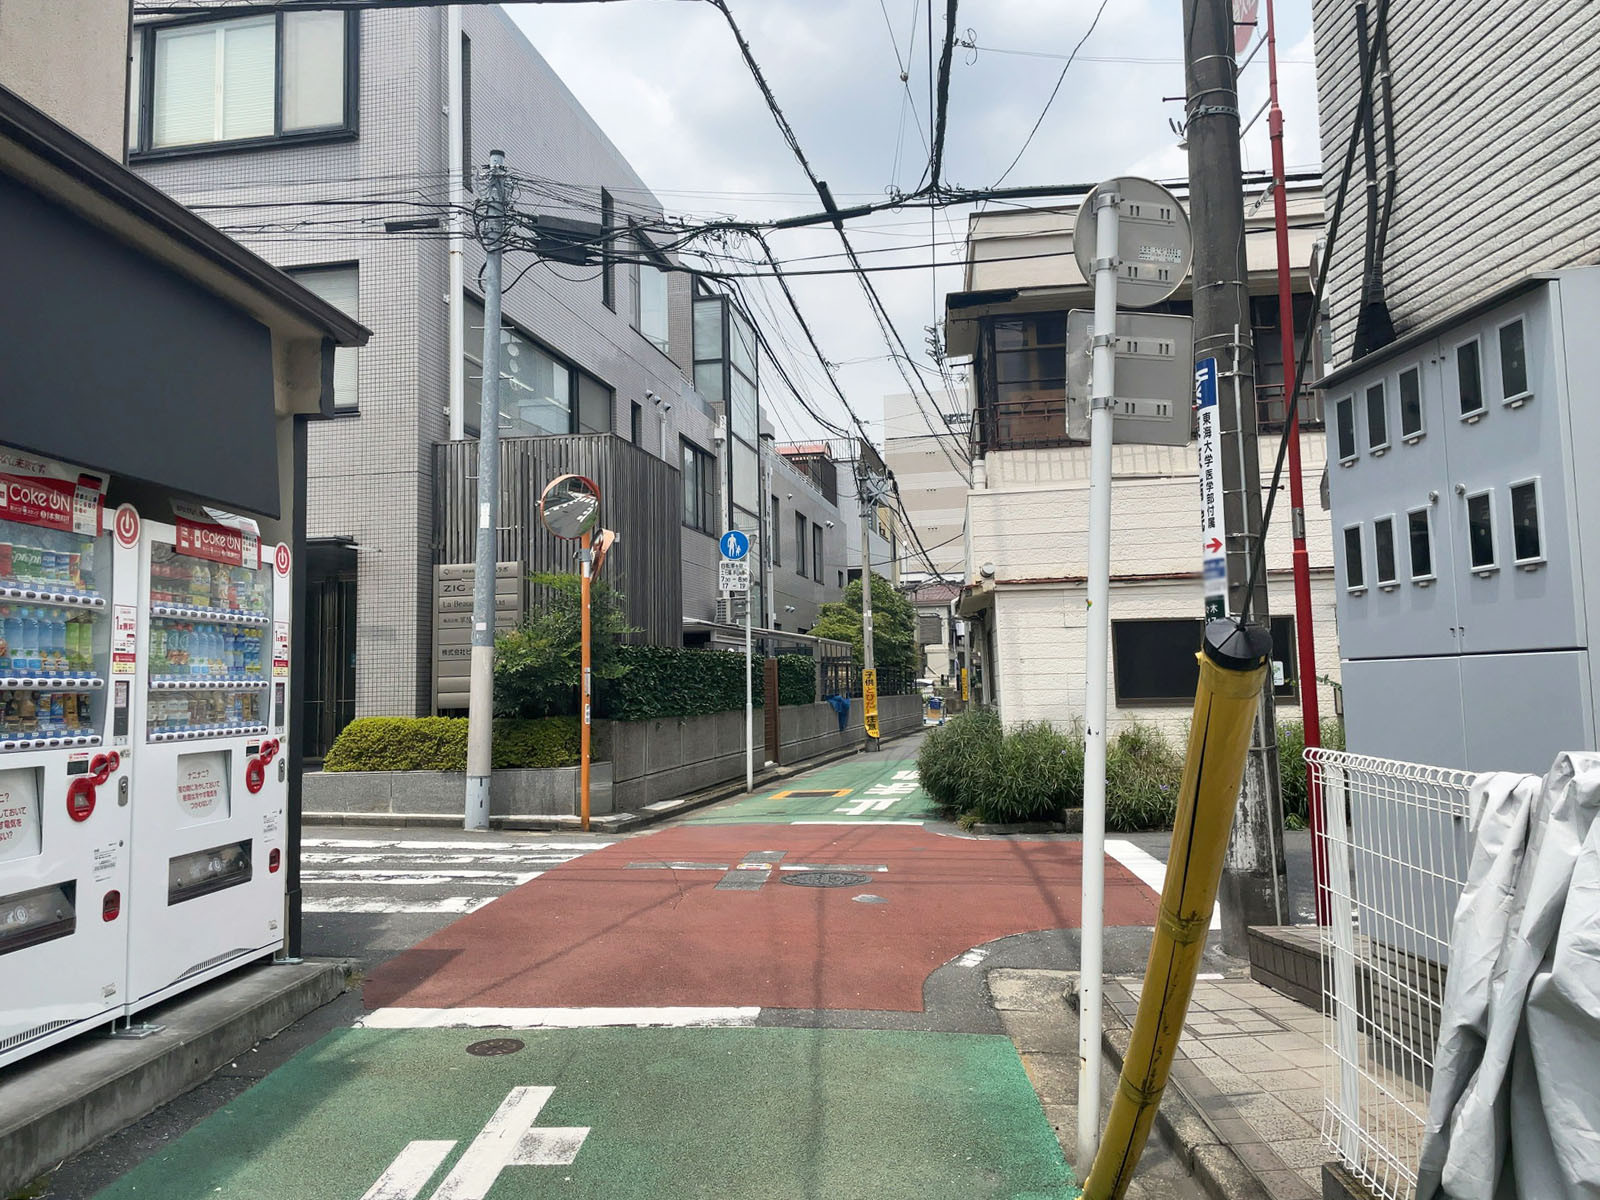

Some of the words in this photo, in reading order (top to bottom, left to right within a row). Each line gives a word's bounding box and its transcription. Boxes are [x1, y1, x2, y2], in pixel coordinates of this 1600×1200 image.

[9, 484, 47, 507] Coke
[201, 529, 226, 547] Coke
[443, 584, 466, 592] ZIG
